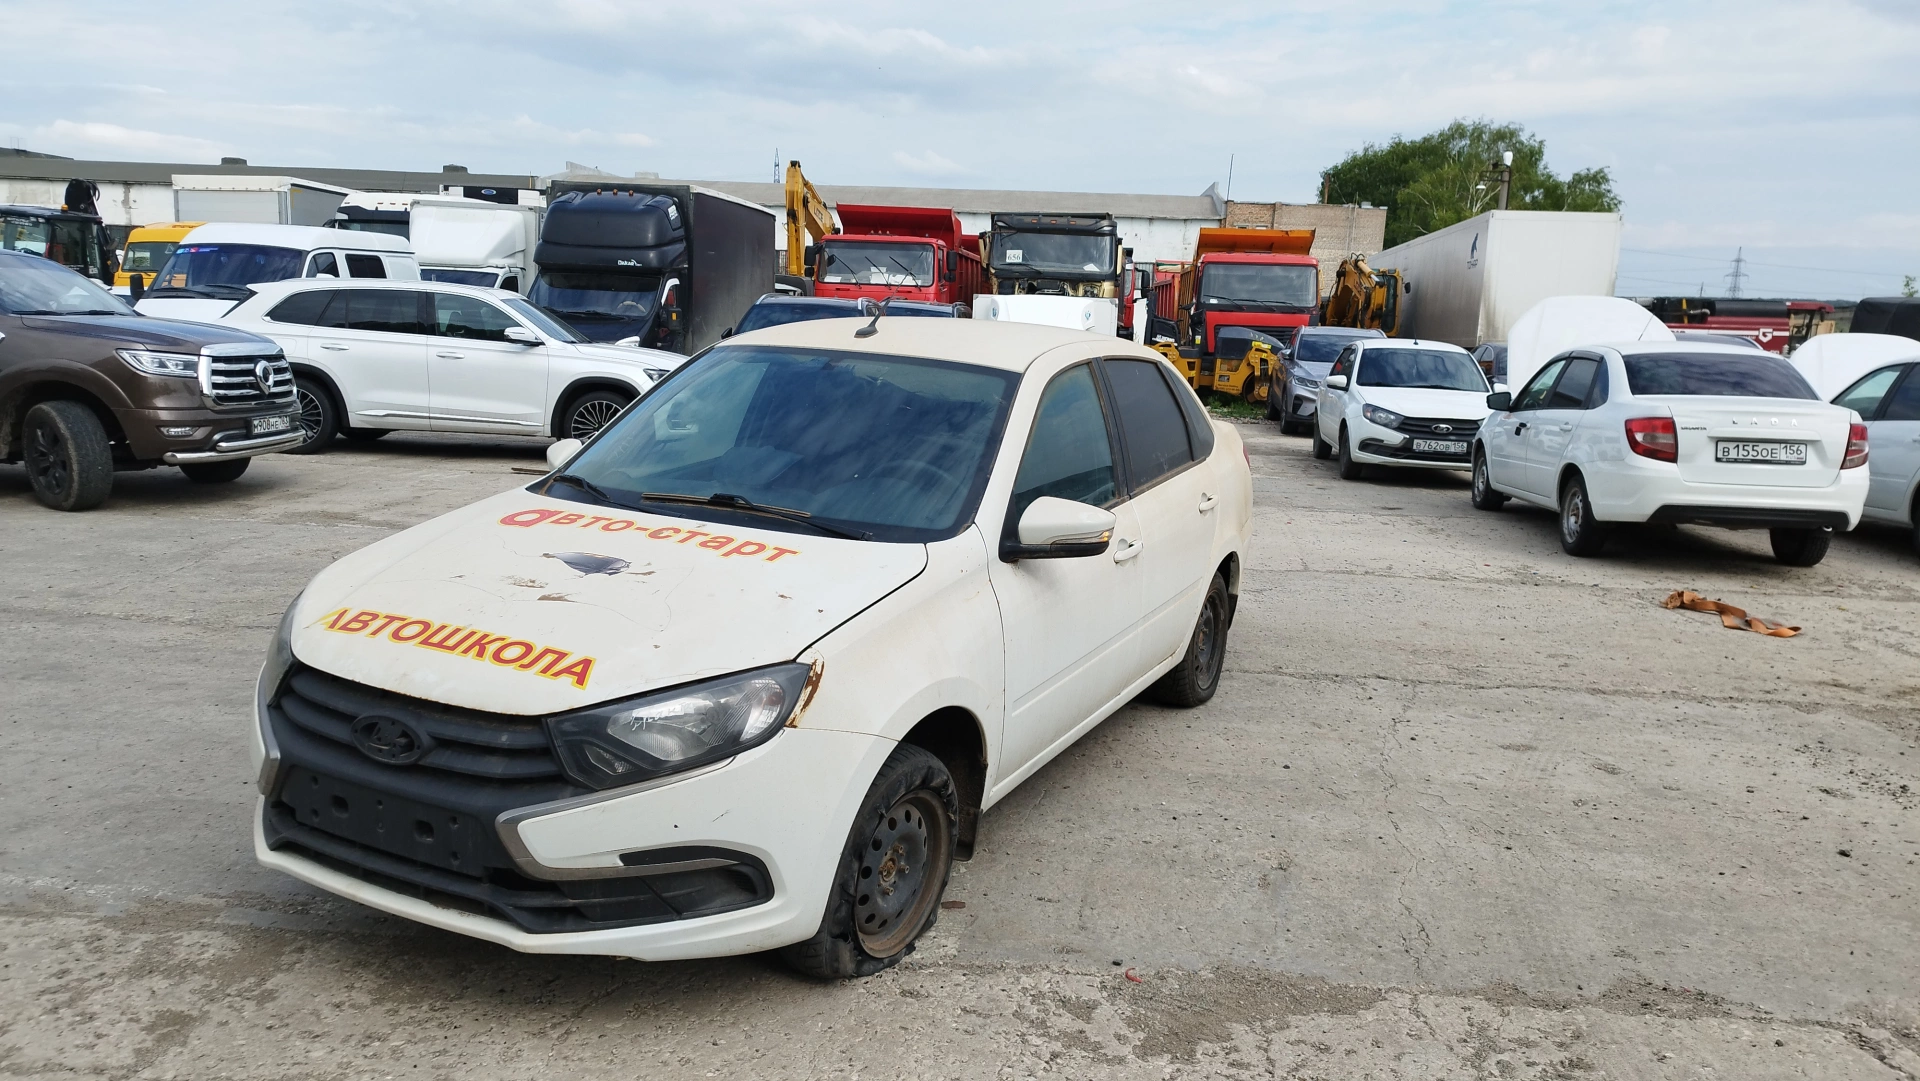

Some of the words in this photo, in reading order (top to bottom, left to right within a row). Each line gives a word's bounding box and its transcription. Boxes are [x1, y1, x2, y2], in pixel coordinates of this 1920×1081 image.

[1007, 253, 1021, 261] 656
[1732, 417, 1798, 427] LADA
[1416, 440, 1450, 451] В762ОВ
[1452, 442, 1466, 450] 156
[1722, 444, 1779, 458] В155ОЕ
[1782, 445, 1803, 456] 156
